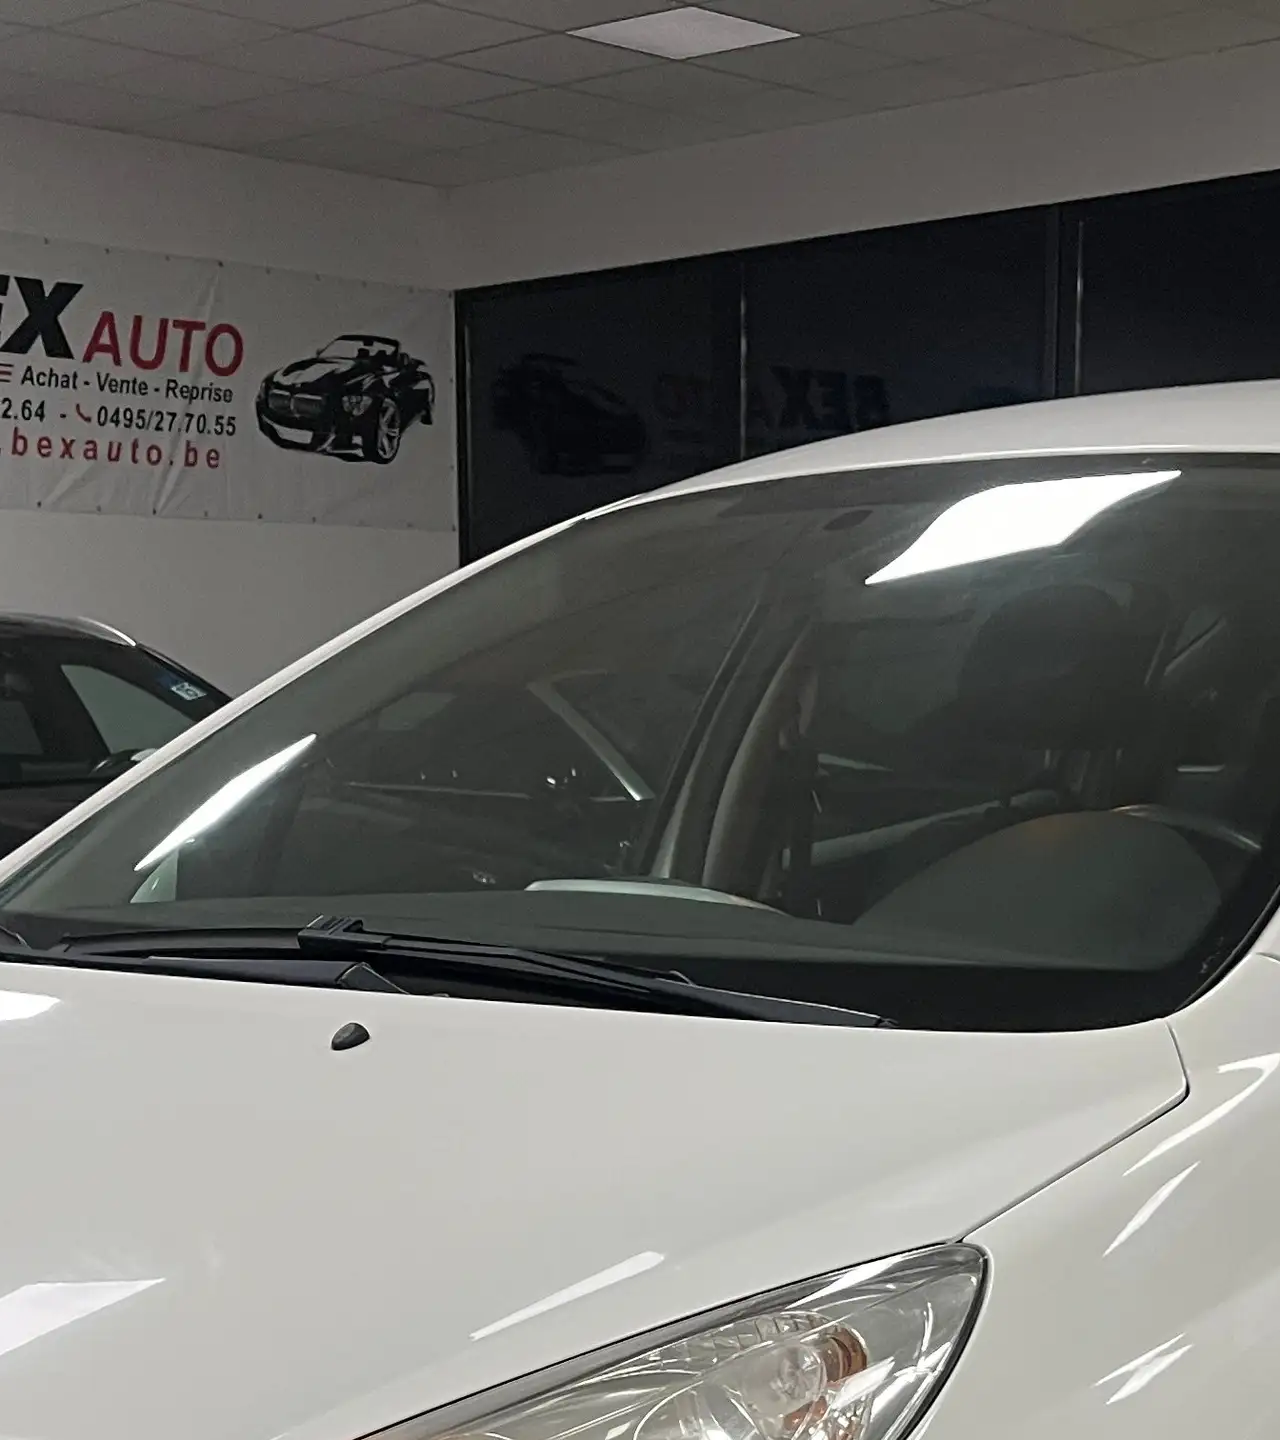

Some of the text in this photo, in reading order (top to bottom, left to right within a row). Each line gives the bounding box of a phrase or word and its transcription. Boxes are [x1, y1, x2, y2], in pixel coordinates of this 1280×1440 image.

[82, 311, 244, 377] AUTO
[21, 366, 79, 390] Achat
[97, 372, 149, 396] Vente
[165, 379, 233, 404] Reprise
[97, 405, 237, 437] 0495/27.70.55
